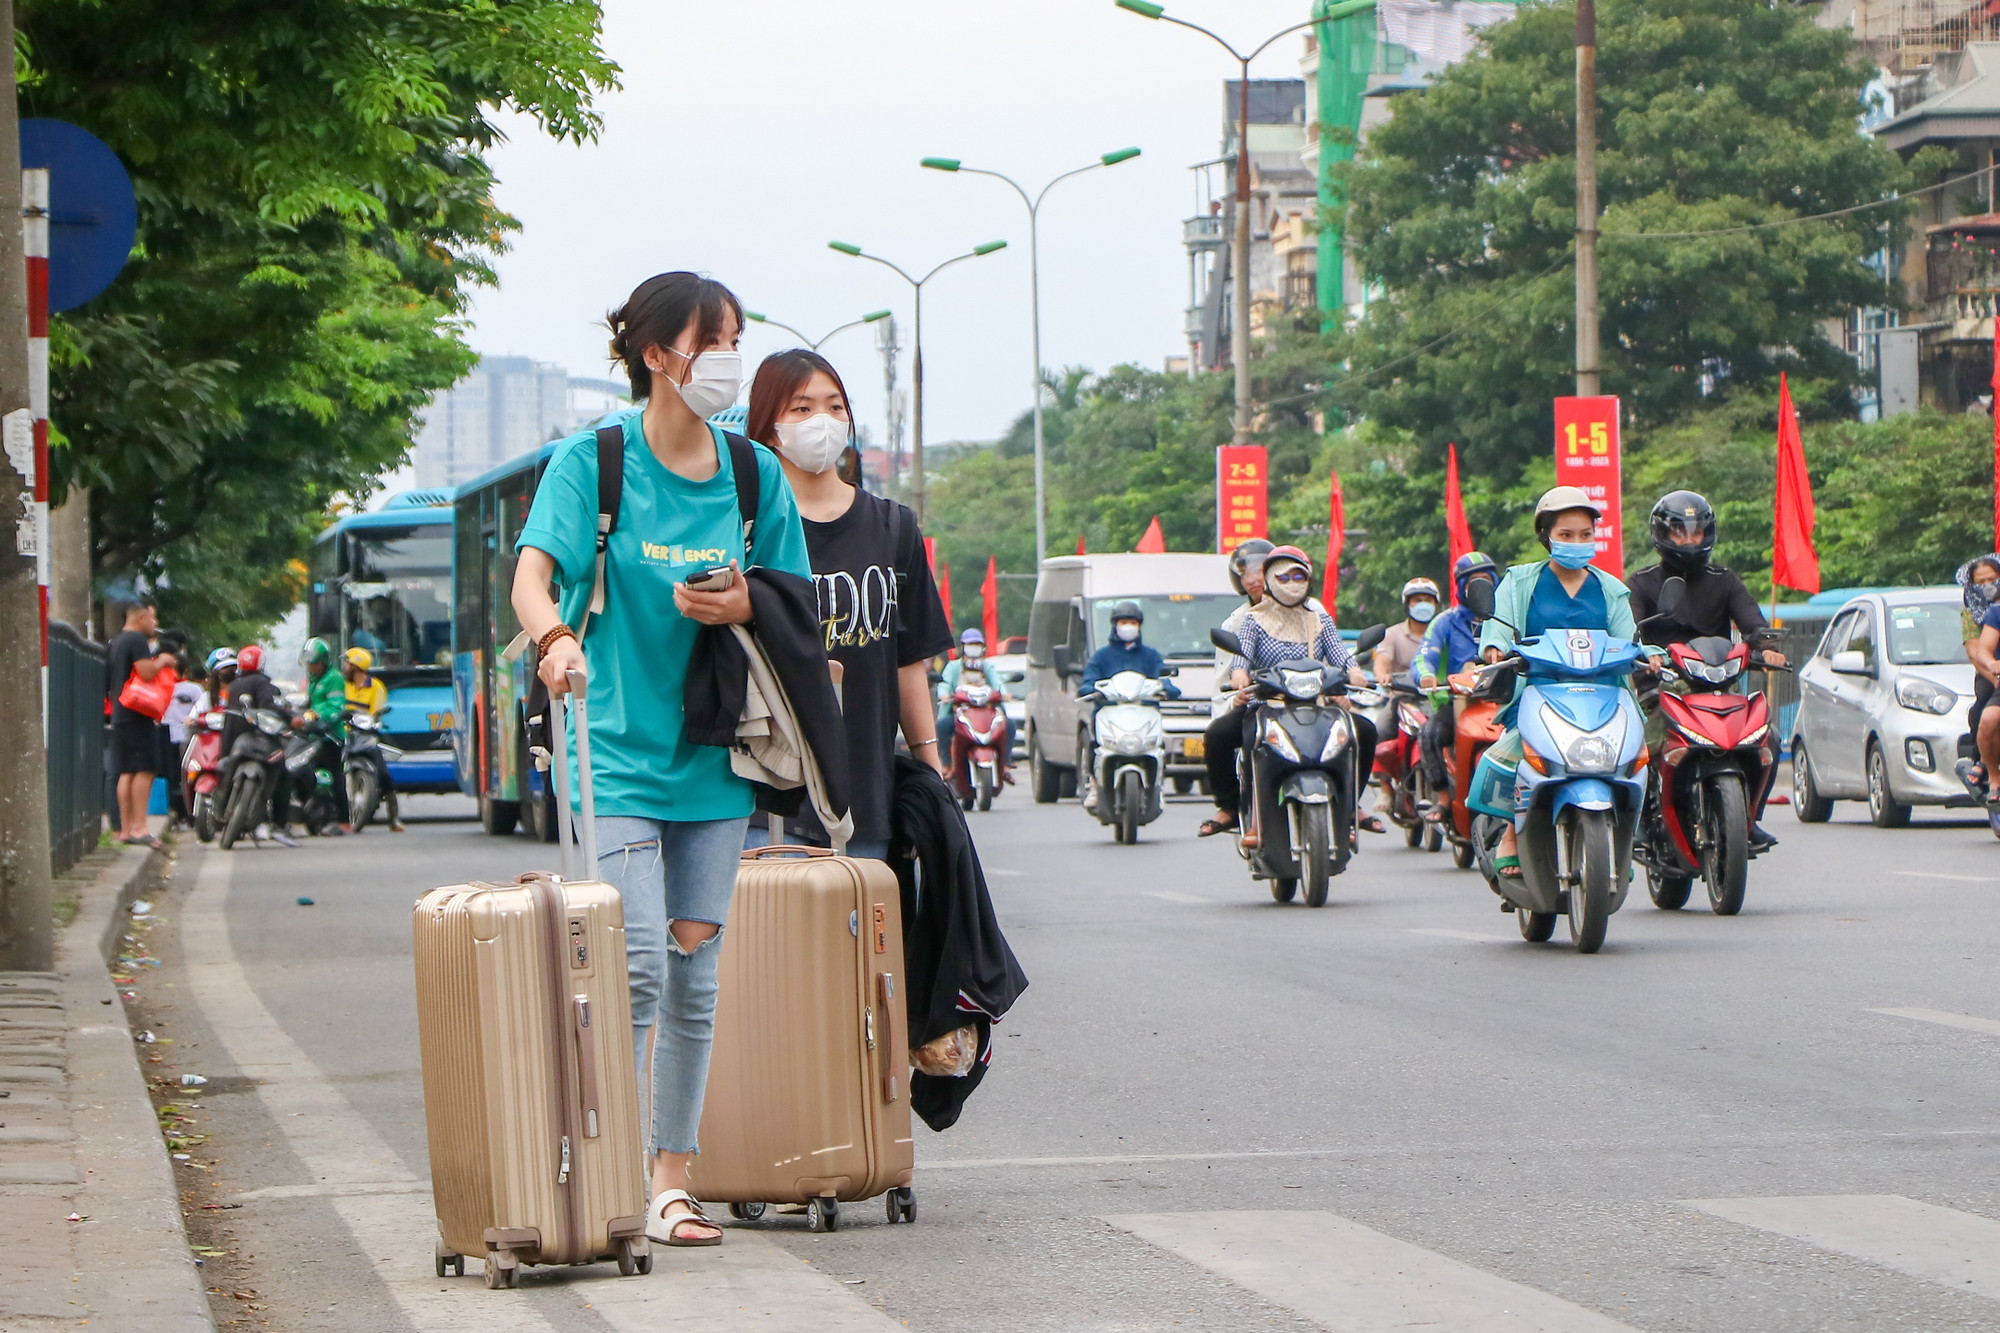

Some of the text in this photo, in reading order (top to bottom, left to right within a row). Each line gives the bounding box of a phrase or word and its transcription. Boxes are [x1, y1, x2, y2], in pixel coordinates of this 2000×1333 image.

[1565, 422, 1607, 455] 1-5
[1230, 463, 1256, 477] 7-5
[642, 541, 726, 563] VERGENCY
